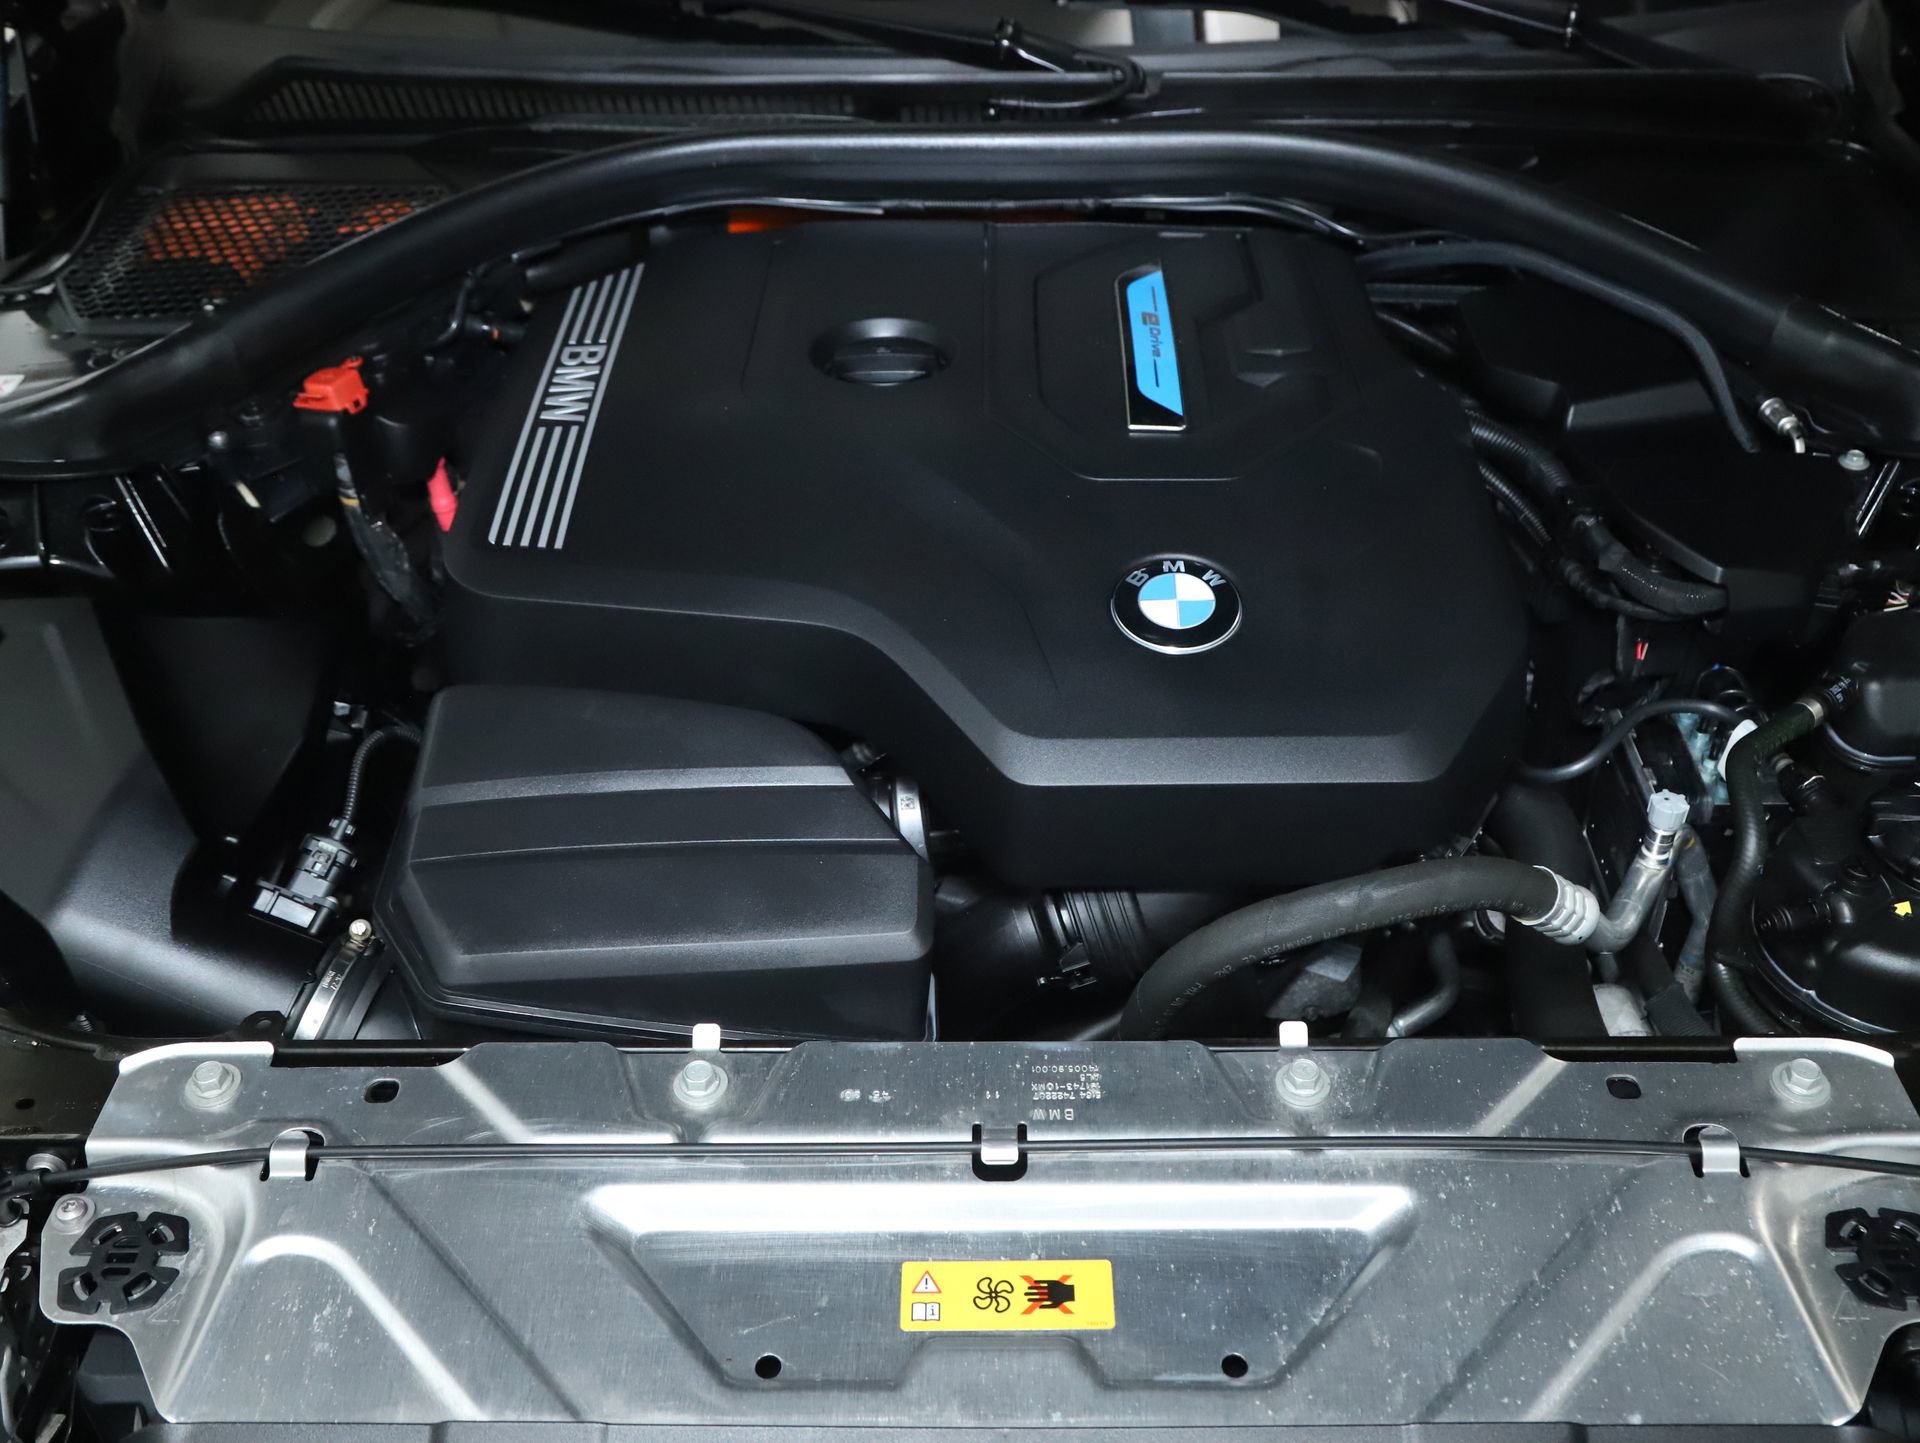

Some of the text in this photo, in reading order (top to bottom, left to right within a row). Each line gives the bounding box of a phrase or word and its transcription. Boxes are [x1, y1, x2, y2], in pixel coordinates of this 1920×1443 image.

[539, 344, 607, 423] BMW
[1125, 560, 1227, 588] BMW
[1032, 1108, 1074, 1121] BMW
